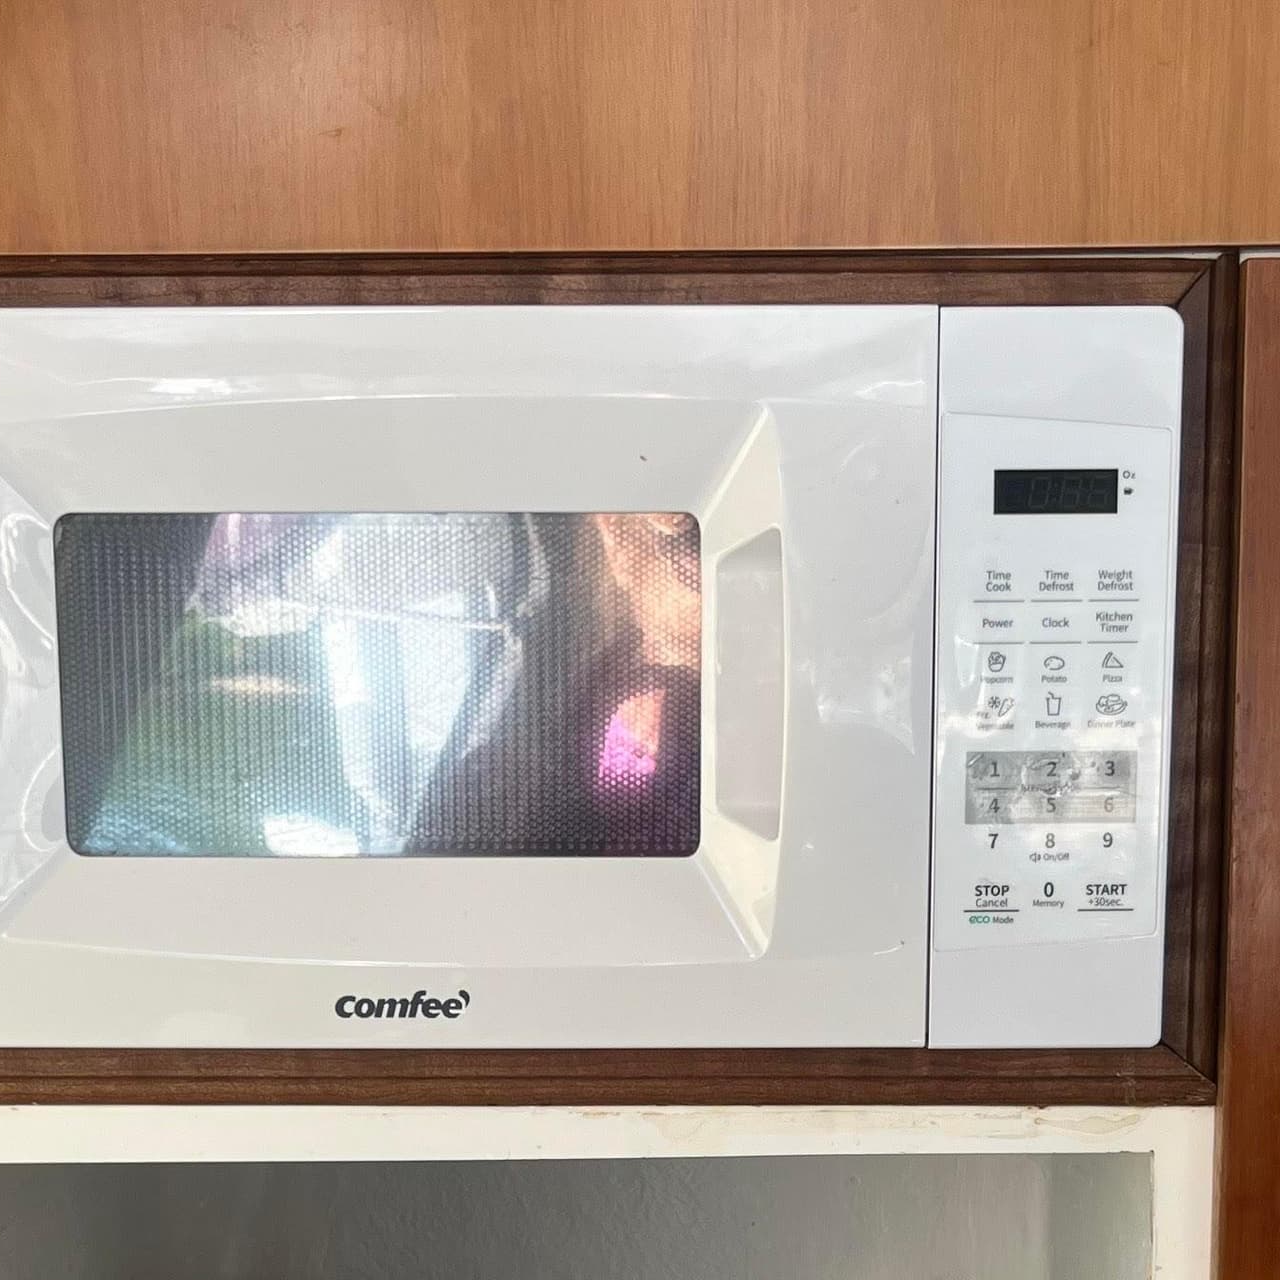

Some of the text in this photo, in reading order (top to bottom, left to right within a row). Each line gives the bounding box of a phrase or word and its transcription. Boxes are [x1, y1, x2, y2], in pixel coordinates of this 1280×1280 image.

[986, 570, 1012, 580] Time
[1045, 570, 1070, 580] Time
[1098, 569, 1133, 582] Weight
[985, 581, 1012, 592] Cook
[1039, 581, 1074, 592] Defrost
[1097, 581, 1134, 592] Defrost
[1041, 617, 1070, 628] Clock
[1095, 612, 1133, 622] Kitchen
[982, 618, 1014, 629] Power
[1100, 623, 1129, 633] Timer
[1041, 675, 1067, 684] Potato
[1102, 674, 1123, 683] Pizza
[990, 762, 1000, 778] 1
[1046, 761, 1058, 778] 2
[1104, 760, 1115, 776] 3
[988, 798, 1000, 814] 4
[1046, 797, 1057, 813] 5
[1103, 797, 1114, 812] 6
[988, 833, 999, 849] 7
[1045, 832, 1056, 849] 8
[1102, 832, 1113, 848] 9
[1043, 852, 1070, 862] On/Off
[975, 885, 1010, 897] STOP
[1043, 882, 1055, 898] 0
[1086, 884, 1128, 896] START
[975, 897, 1008, 908] Cancel
[1032, 899, 1064, 909] Memory
[992, 916, 1014, 924] Mode
